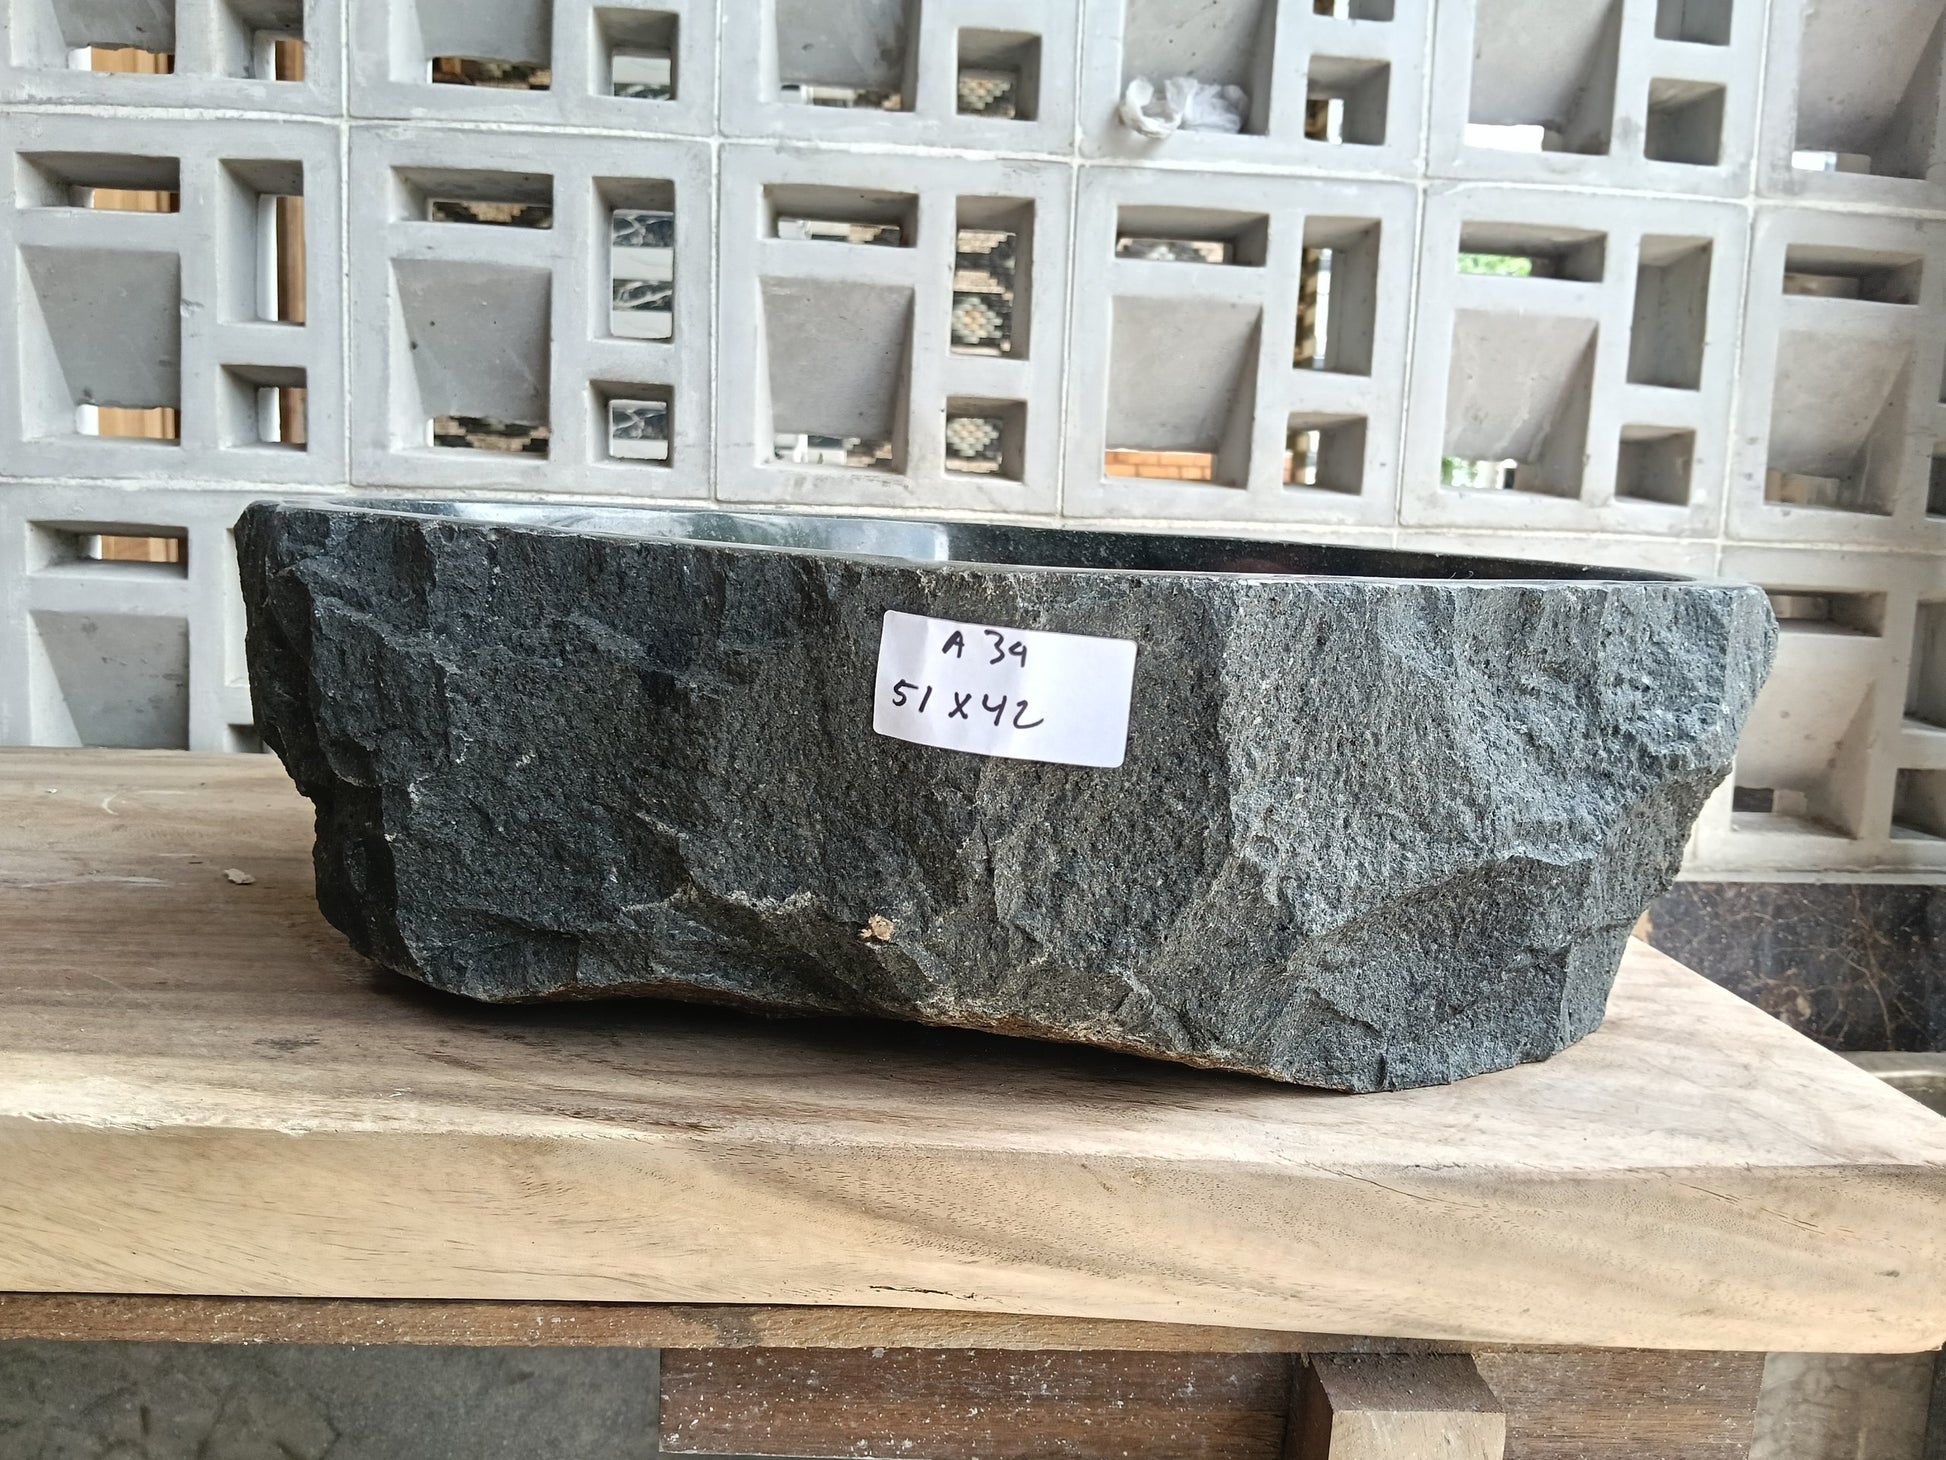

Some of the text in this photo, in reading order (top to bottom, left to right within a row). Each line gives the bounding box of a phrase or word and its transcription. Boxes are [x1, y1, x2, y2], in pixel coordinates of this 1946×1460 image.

[941, 629, 1027, 668] A 39
[892, 678, 933, 713] 51
[981, 693, 1044, 729] 42
